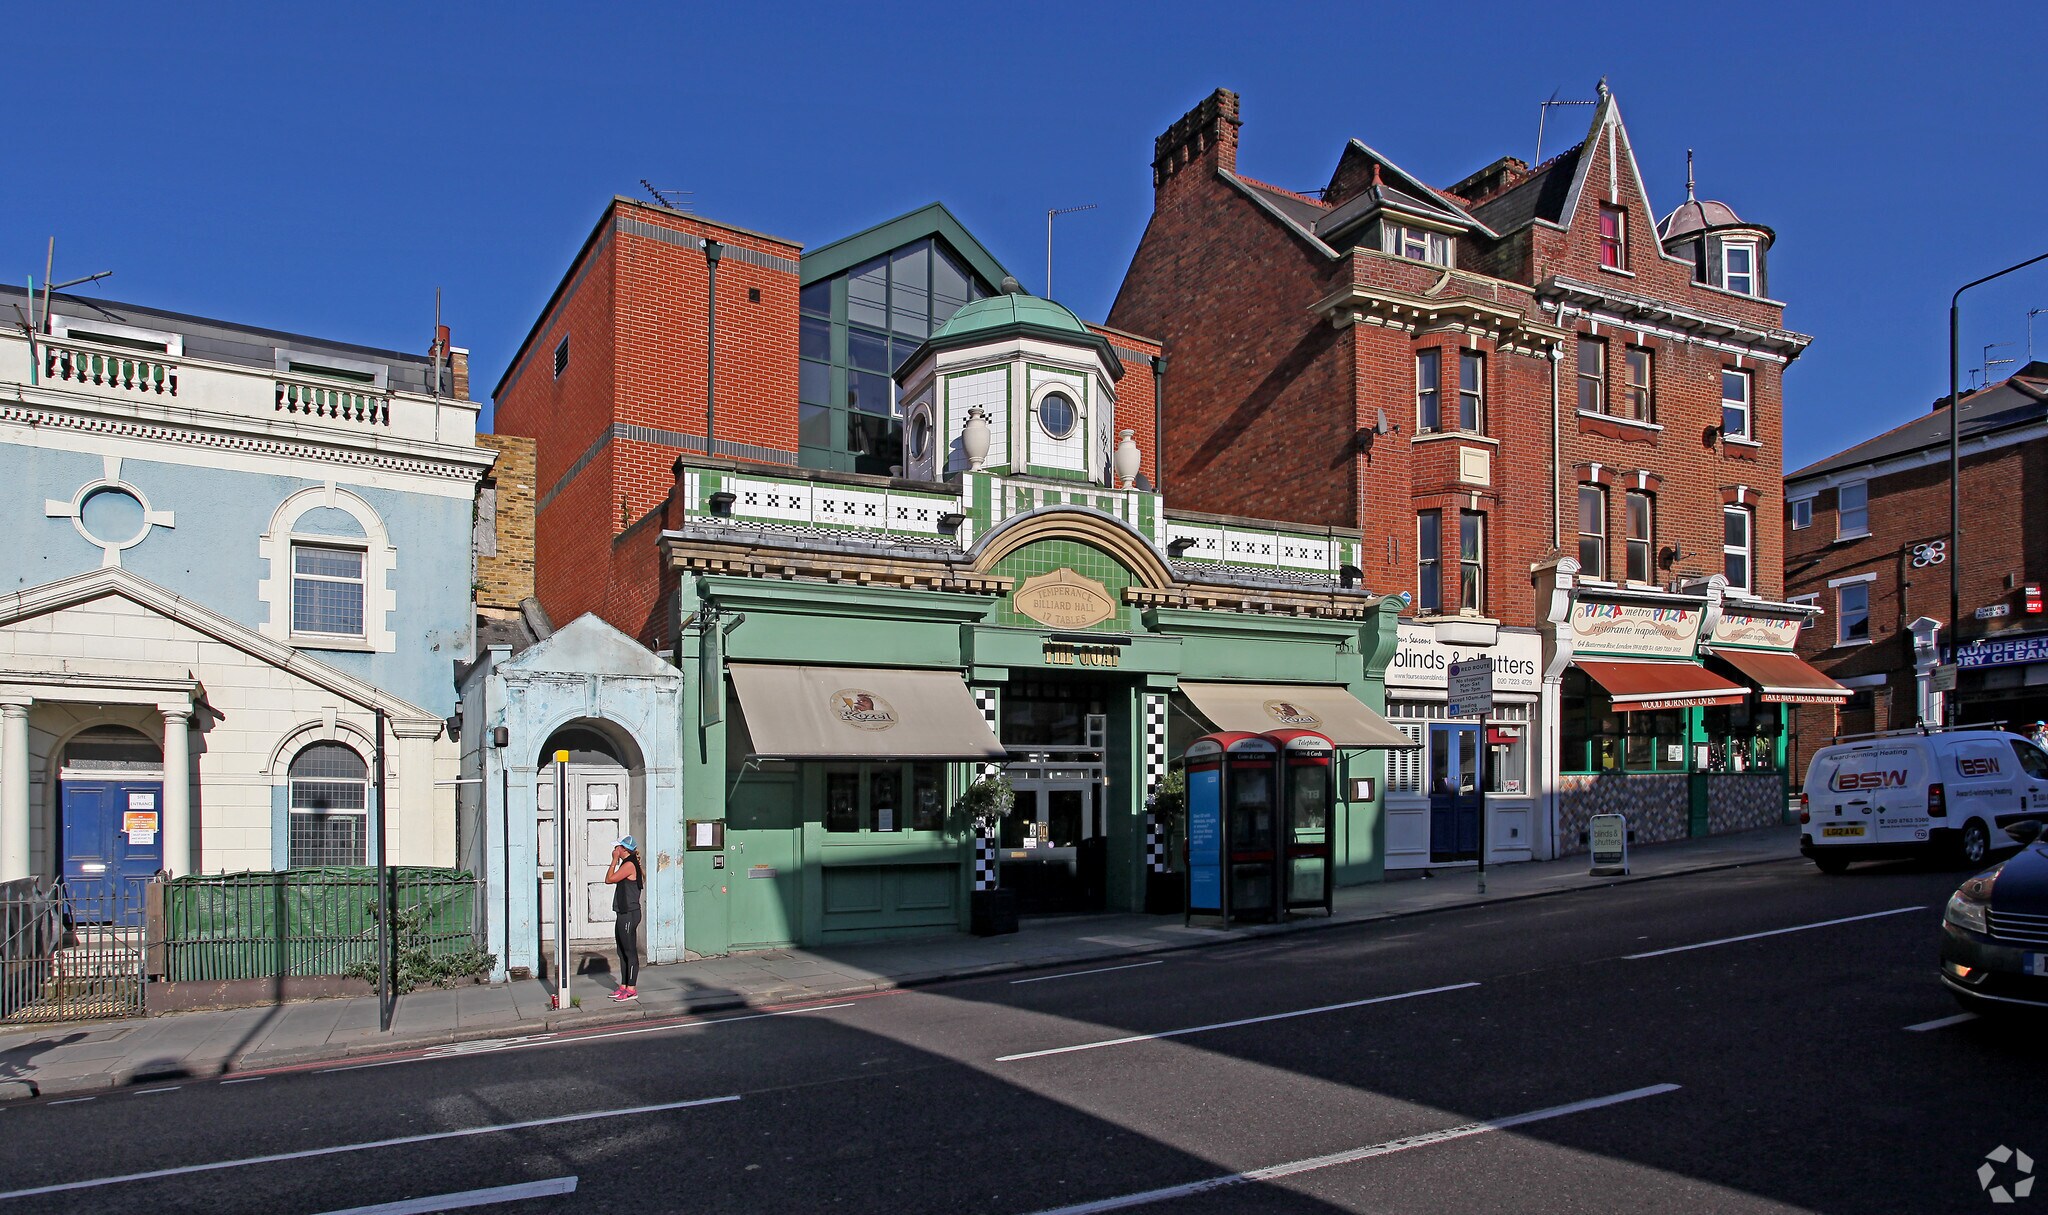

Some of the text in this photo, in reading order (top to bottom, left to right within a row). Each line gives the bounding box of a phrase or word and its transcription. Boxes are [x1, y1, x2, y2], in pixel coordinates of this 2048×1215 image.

[1037, 587, 1093, 603] TEMPERANCE
[1033, 599, 1096, 612] BILLIARD HALL
[1042, 612, 1087, 625] 17 TABLES
[1585, 603, 1687, 622] PIZZA metro PIZZA
[1727, 615, 1753, 625] PIZZA
[1766, 618, 1790, 629] PIZZA
[1593, 624, 1678, 639] ristorante napoletano
[1409, 633, 1431, 644] Seasons
[1043, 643, 1121, 667] THE GOAT
[1394, 648, 1445, 670] blinds
[1467, 653, 1534, 675] utters
[1497, 677, 1508, 685] 020
[1664, 698, 1696, 707] BURNING
[1698, 697, 1716, 705] OVEN
[1240, 741, 1263, 750] Telephone
[1298, 739, 1320, 747] Telephone
[1829, 751, 1878, 761] Award-winning
[1960, 758, 2000, 774] BSW
[1839, 770, 1908, 790] BSW
[1613, 829, 1618, 837] &
[1594, 838, 1621, 846] shutters
